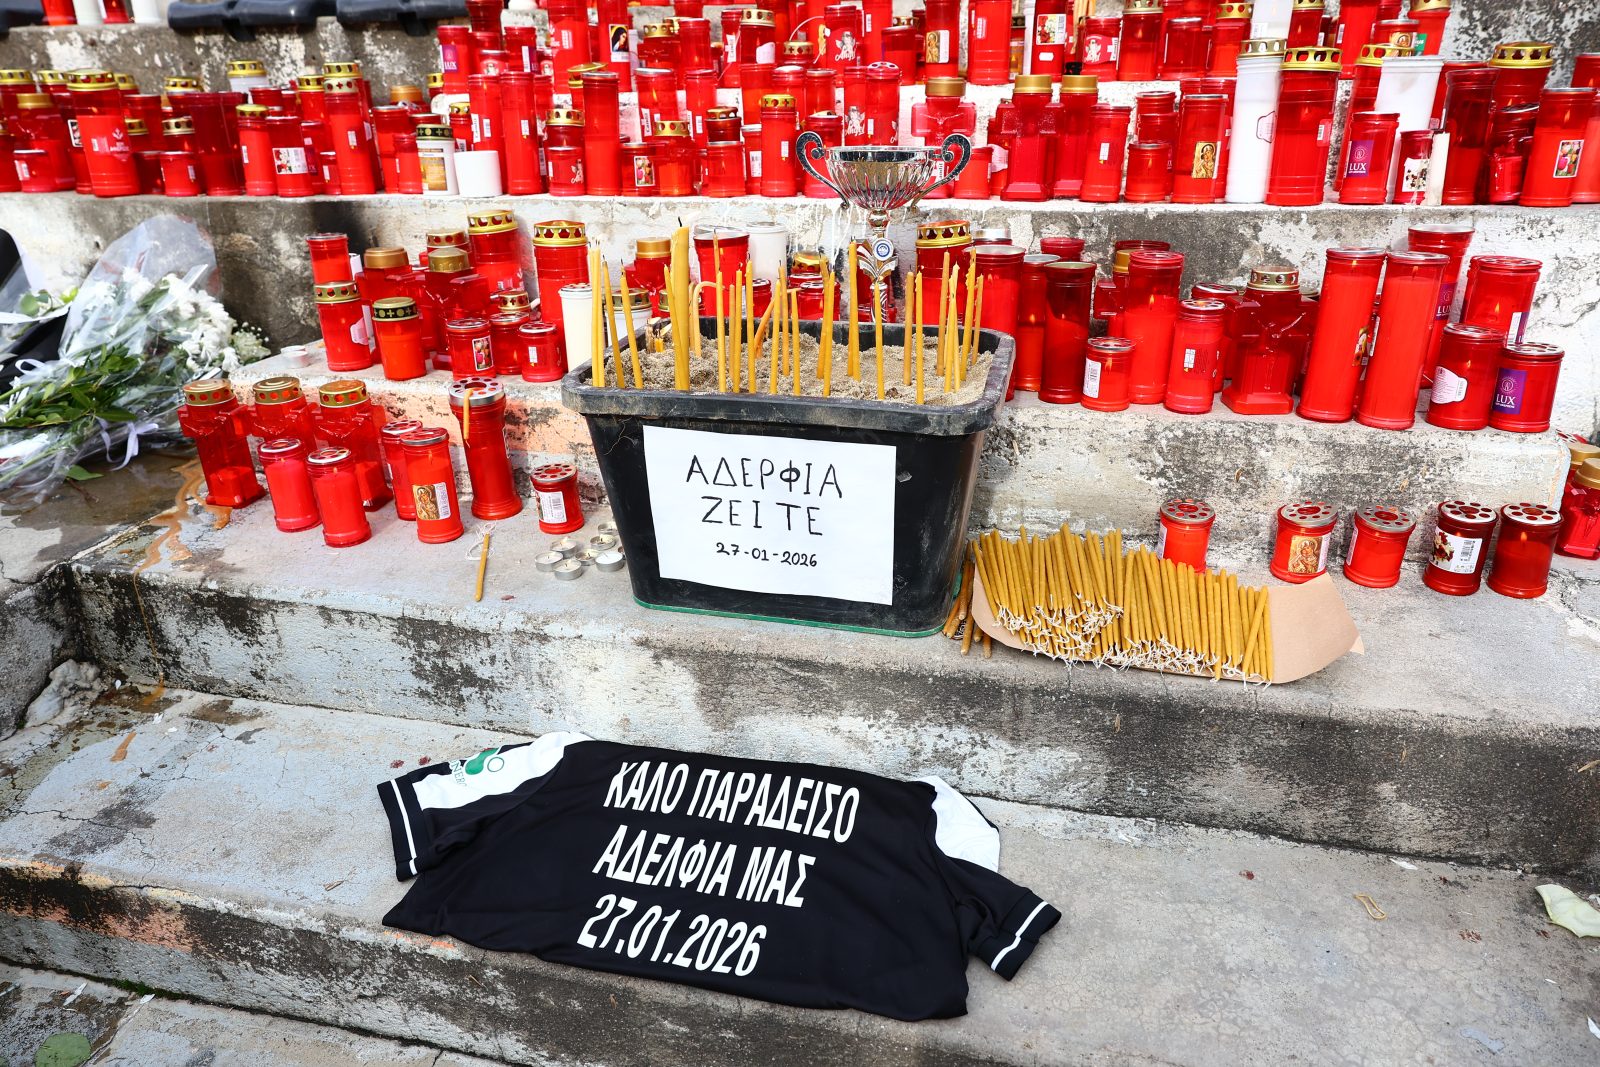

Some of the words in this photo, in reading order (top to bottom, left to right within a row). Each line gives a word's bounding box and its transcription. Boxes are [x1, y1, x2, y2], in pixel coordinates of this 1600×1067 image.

[1349, 162, 1367, 171] LUX
[1496, 394, 1516, 406] LUX
[686, 454, 843, 499] ΑΔΕΡΦΙΑ
[715, 542, 818, 568] 27-01-2026
[603, 761, 690, 814] ΚΑΛΟ
[686, 768, 860, 843] ΠΑΡΑΔΕΙΣΟ
[592, 824, 737, 897] ΑΔΕΛΦΙΑ
[736, 846, 817, 908] ΜΑΣ
[576, 893, 768, 977] 27.01.2026
